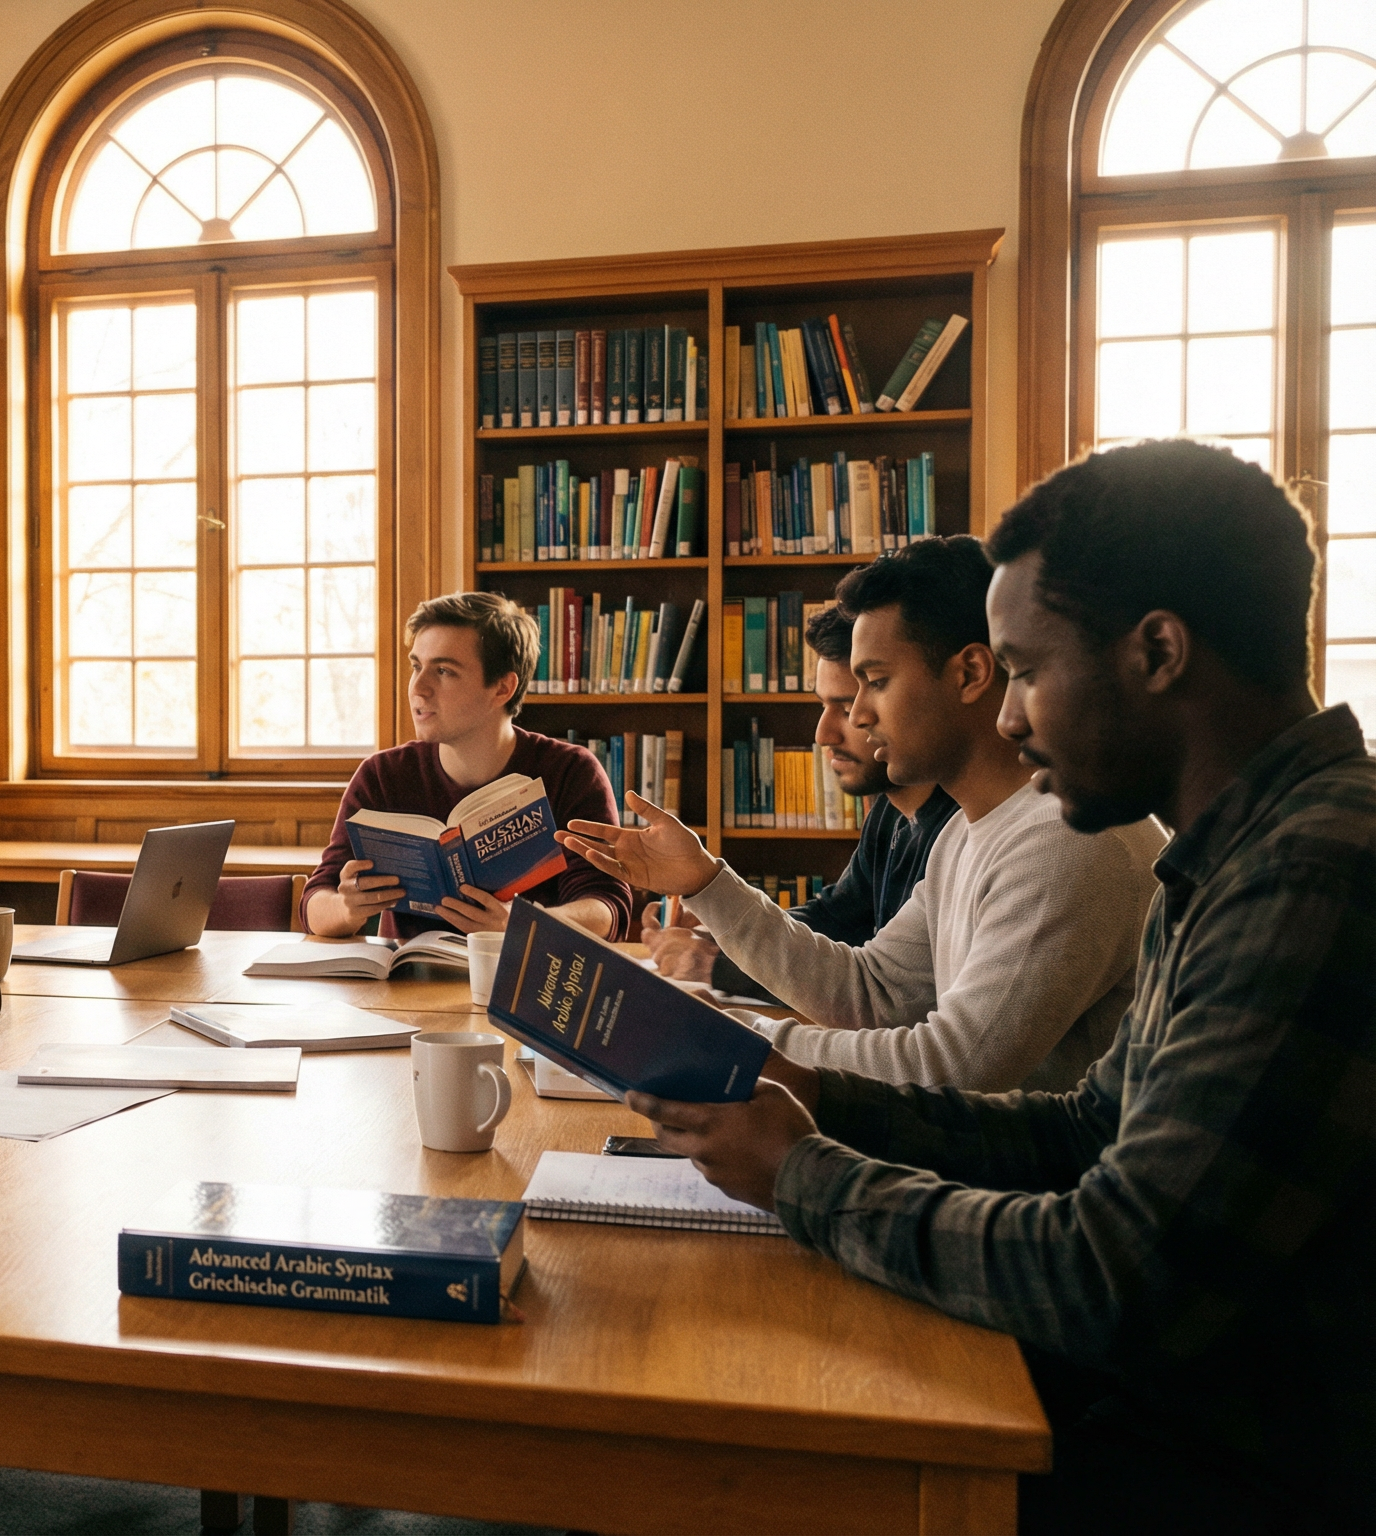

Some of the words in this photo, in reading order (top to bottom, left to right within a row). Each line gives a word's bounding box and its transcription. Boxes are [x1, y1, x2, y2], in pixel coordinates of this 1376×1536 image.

[189, 1247, 270, 1271] Advanced
[275, 1253, 331, 1276] Arabic
[335, 1258, 394, 1282] Syntax
[189, 1272, 288, 1297] Griechische
[291, 1280, 391, 1305] Grammatik
